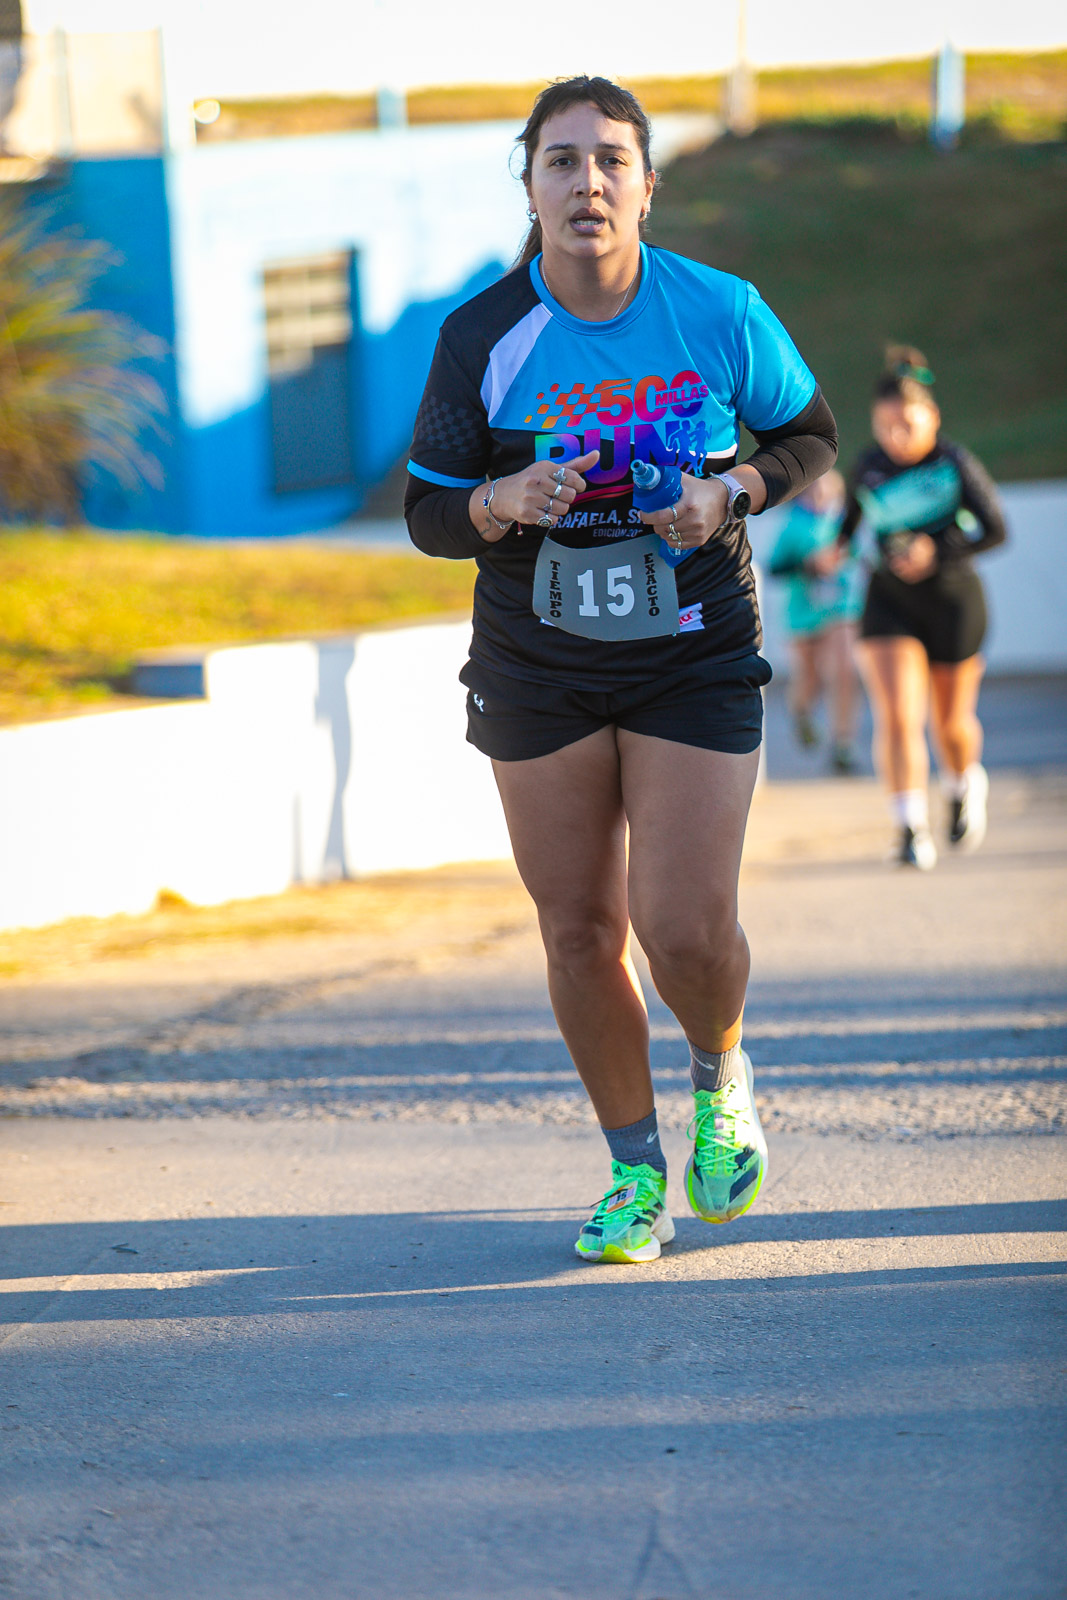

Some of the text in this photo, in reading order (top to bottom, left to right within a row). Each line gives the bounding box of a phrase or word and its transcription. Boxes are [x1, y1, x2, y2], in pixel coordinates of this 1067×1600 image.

[656, 385, 709, 406] MILLAS
[550, 560, 562, 618] TIEMPO
[577, 565, 635, 617] 15
[644, 553, 660, 617] EXACTO
[617, 1191, 627, 1201] 15
